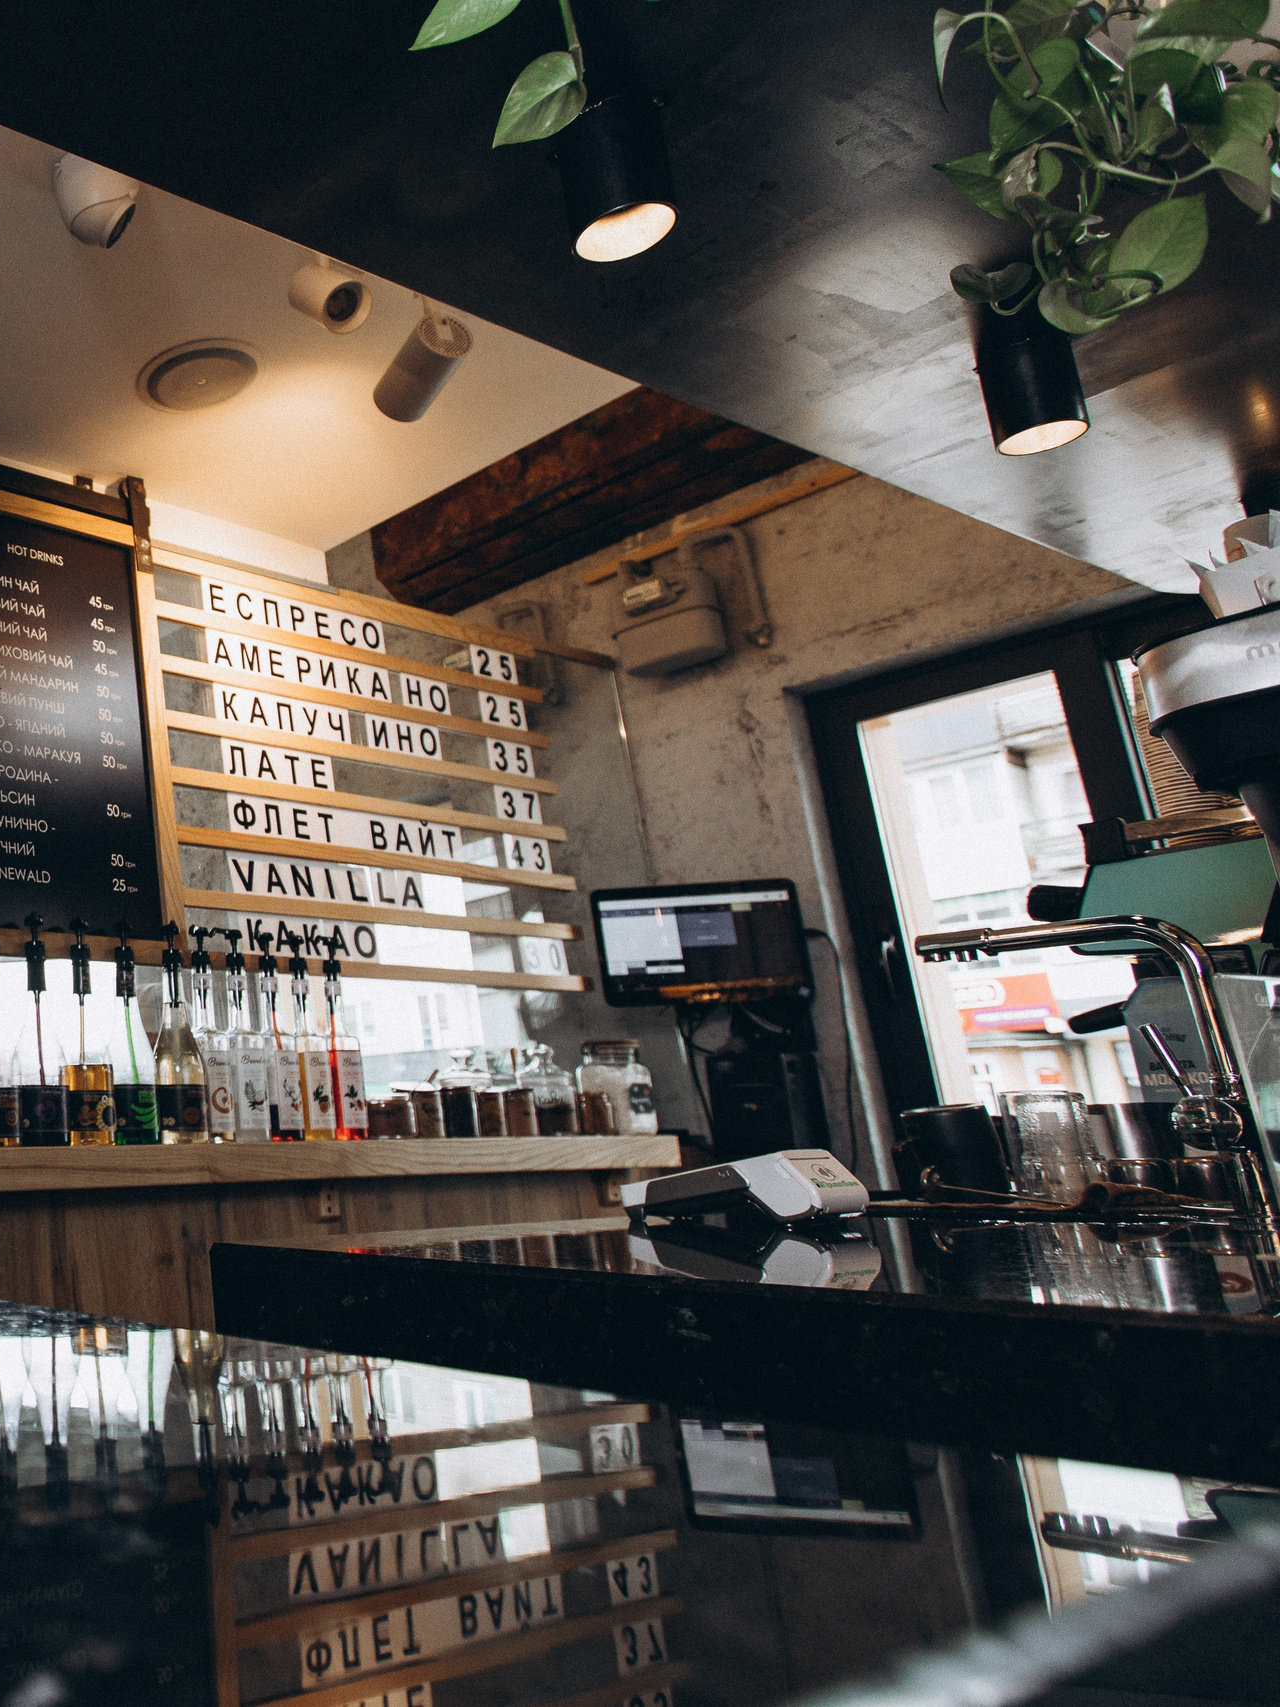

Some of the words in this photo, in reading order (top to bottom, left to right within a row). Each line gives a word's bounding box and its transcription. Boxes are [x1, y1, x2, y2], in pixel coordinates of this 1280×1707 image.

[7, 543, 28, 557] HOT
[30, 549, 64, 567] DRINKS
[15, 578, 40, 595] ЧАЙ
[89, 595, 103, 609] 45
[20, 603, 46, 619] ЧАЙ
[90, 617, 104, 631] 45
[22, 626, 48, 642] ЧАЙ
[92, 639, 106, 653] 50
[208, 583, 380, 650] ЕСПРЕСО
[476, 649, 513, 682] 25
[48, 653, 74, 670] ЧАЙ
[94, 663, 108, 676] 45
[10, 671, 79, 693] МАНДАРИН
[96, 685, 110, 699] 50
[29, 696, 65, 715] ПУНШ
[98, 707, 112, 722] 50
[488, 695, 522, 728] 25
[100, 731, 114, 745] 50
[23, 744, 82, 765] МАРАКУЯ
[102, 755, 116, 769] 50
[493, 741, 529, 774] 35
[228, 745, 329, 790] ЛАТЕ
[501, 790, 536, 820] 37
[106, 803, 120, 818] 50
[233, 799, 333, 844] ФЛЕТ
[369, 819, 457, 860] ВАЙТ
[511, 840, 546, 871] 43
[110, 853, 124, 868] 50
[112, 878, 126, 892] 25
[232, 858, 424, 909] VANILLA
[246, 917, 378, 959] КАКАО
[523, 942, 562, 971] 30
[1143, 1071, 1210, 1086] MOKO
